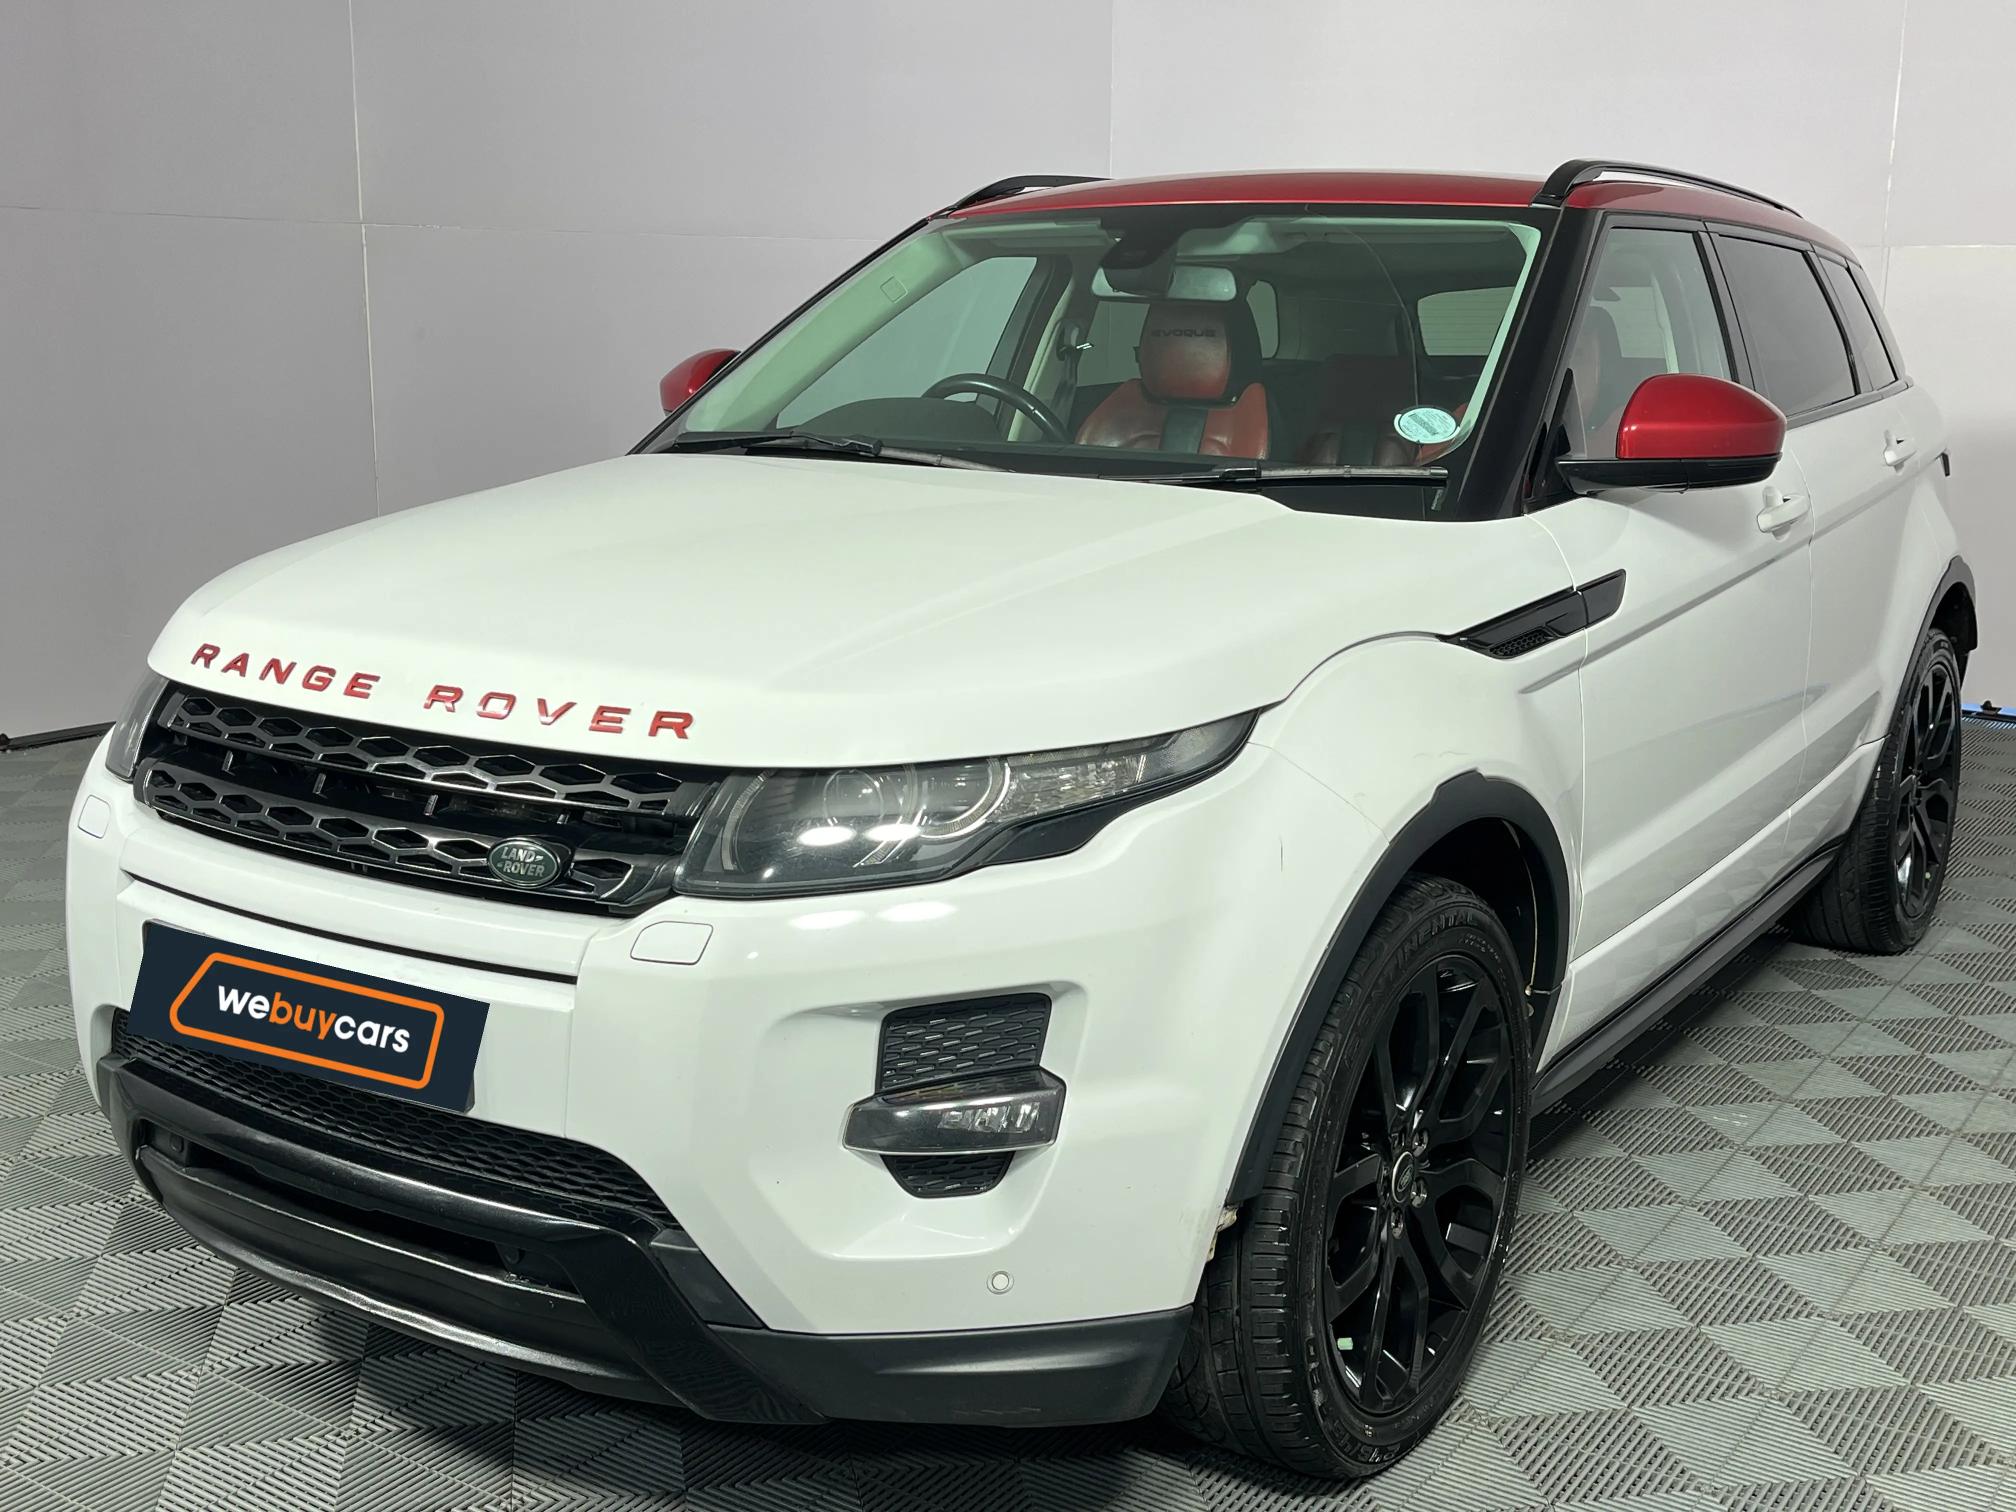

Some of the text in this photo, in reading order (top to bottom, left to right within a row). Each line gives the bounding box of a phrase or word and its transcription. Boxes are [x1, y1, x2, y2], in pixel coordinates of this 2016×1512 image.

[191, 643, 696, 740] RANGE ROVER
[501, 847, 536, 862] LAND
[503, 861, 545, 877] ROVER
